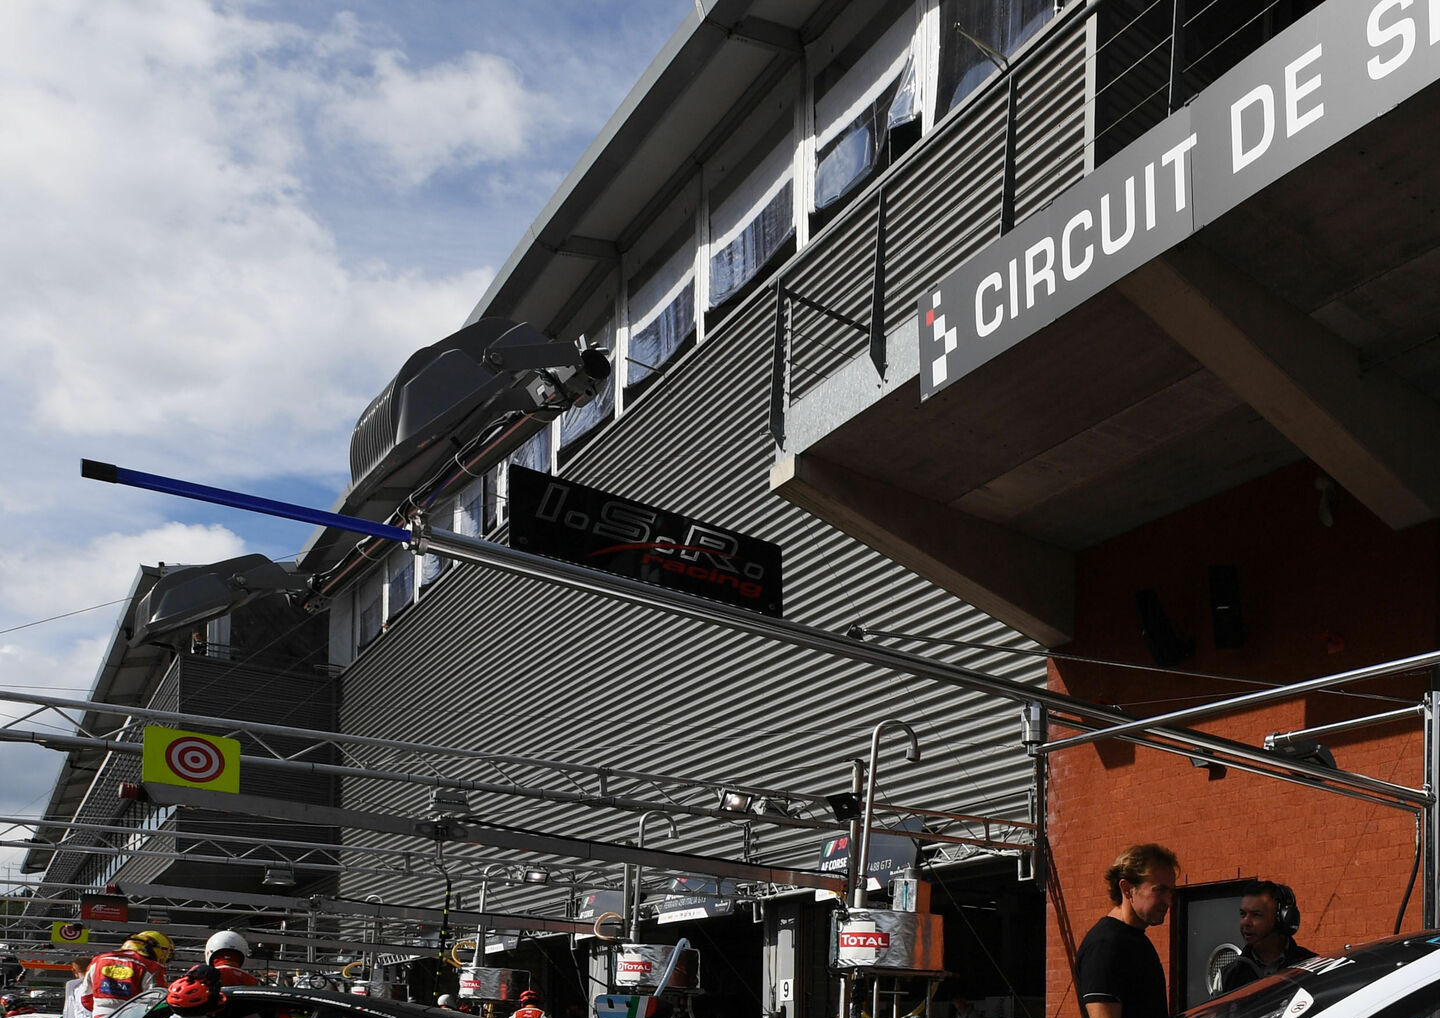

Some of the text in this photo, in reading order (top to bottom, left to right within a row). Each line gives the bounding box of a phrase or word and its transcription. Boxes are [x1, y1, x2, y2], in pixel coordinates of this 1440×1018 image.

[974, 133, 1198, 339] CIRCUIT
[1230, 43, 1325, 174] DE
[641, 552, 763, 599] racing
[841, 933, 888, 946] TOTAL
[624, 963, 650, 971] TOTAL
[783, 981, 790, 999] 9
